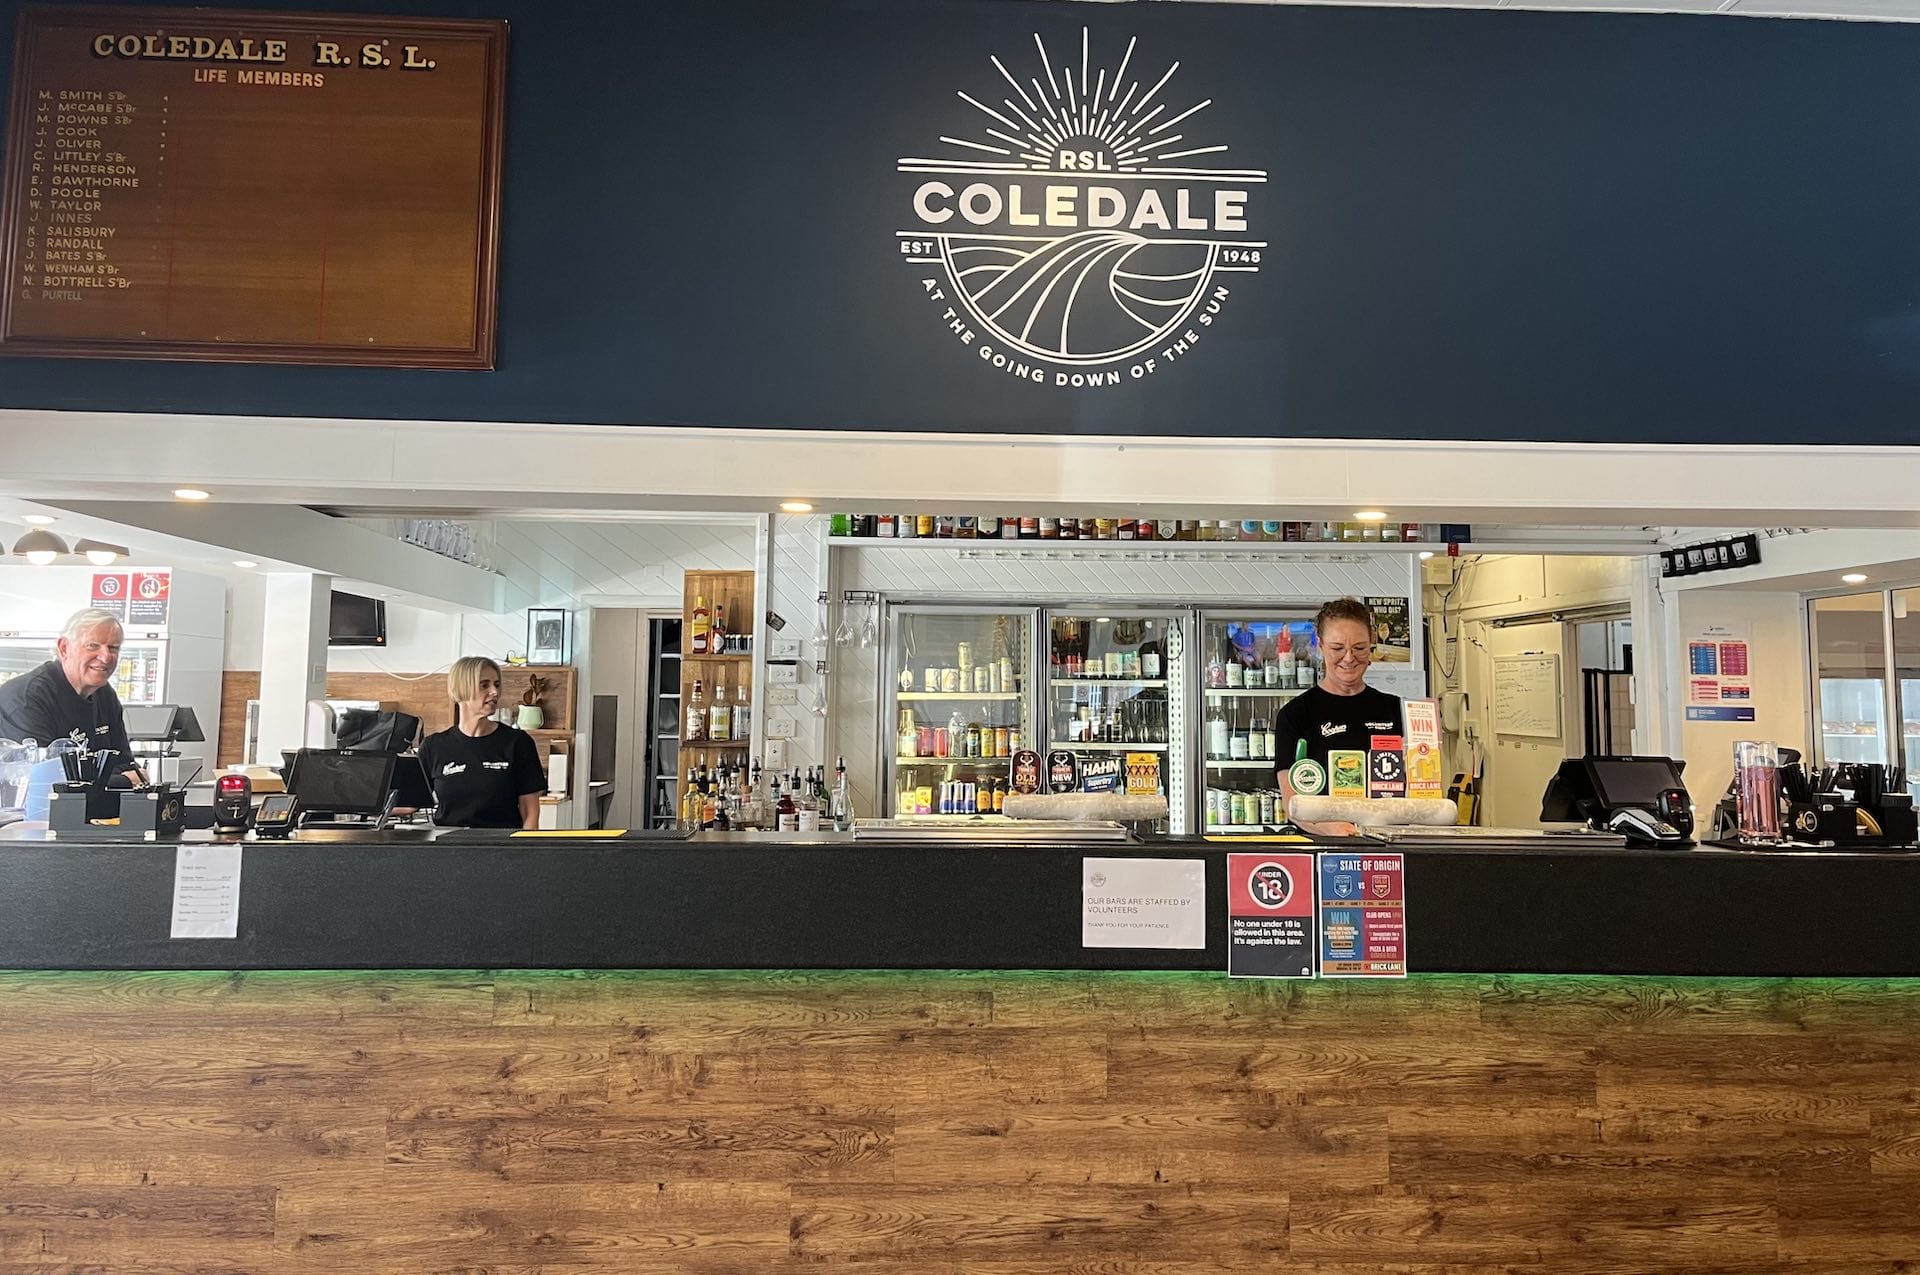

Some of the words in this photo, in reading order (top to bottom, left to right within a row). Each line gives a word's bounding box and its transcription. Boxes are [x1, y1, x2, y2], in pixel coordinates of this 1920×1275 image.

[94, 34, 288, 62] COLEDALE
[316, 42, 351, 65] R.
[362, 42, 391, 67] S.
[404, 46, 436, 69] L.
[194, 69, 227, 83] LIFE
[237, 71, 324, 88] MEMBERS
[60, 92, 102, 100] SMITH
[58, 104, 112, 112] McCABE
[57, 116, 108, 124] DOWNS
[56, 128, 97, 136] COOK
[56, 140, 101, 149] OLIVER
[54, 152, 101, 162] LITTLEY
[1059, 150, 1112, 171] RSL
[53, 164, 136, 174] HENDERSON
[52, 176, 139, 187] GAWTHORNE
[51, 189, 100, 198] POOLE
[50, 201, 101, 212] TAYLOR
[913, 181, 1248, 232] COLEDALE
[51, 214, 92, 223] INNES
[47, 226, 116, 237] SALISBURY
[46, 238, 103, 249] RANDALL
[899, 241, 933, 254] EST
[46, 251, 80, 260] BATES
[1222, 250, 1261, 263] 1948
[45, 264, 94, 274] WENHAM
[44, 276, 104, 288] BOTTRELL
[42, 290, 82, 301] PURTELL
[922, 277, 945, 303] AT
[941, 307, 975, 346] THE
[979, 345, 1044, 383] GOING
[1056, 370, 1121, 387] DOWN
[1130, 358, 1158, 380] OF
[1162, 332, 1200, 362] THE
[1199, 285, 1231, 327] SUN
[1374, 606, 1387, 614] WHO
[1411, 719, 1433, 732] WIN
[1083, 760, 1120, 776] HAHN
[1126, 764, 1158, 776] XXXX
[1016, 774, 1037, 782] OLD
[1052, 774, 1072, 782] NEW
[1130, 778, 1156, 788] GOLD
[1340, 860, 1361, 871] STATE
[1362, 861, 1373, 871] OF
[1374, 861, 1400, 871] ORIGIN
[1258, 880, 1283, 900] 18
[1358, 882, 1366, 890] VS
[1145, 898, 1178, 906] STAFFED
[1181, 898, 1191, 906] BY
[1088, 906, 1138, 914] VOLUNTEERS
[1331, 912, 1350, 924] WIN
[1294, 920, 1301, 928] is
[1246, 937, 1273, 946] against
[1274, 937, 1286, 945] the
[1287, 937, 1302, 945] law.
